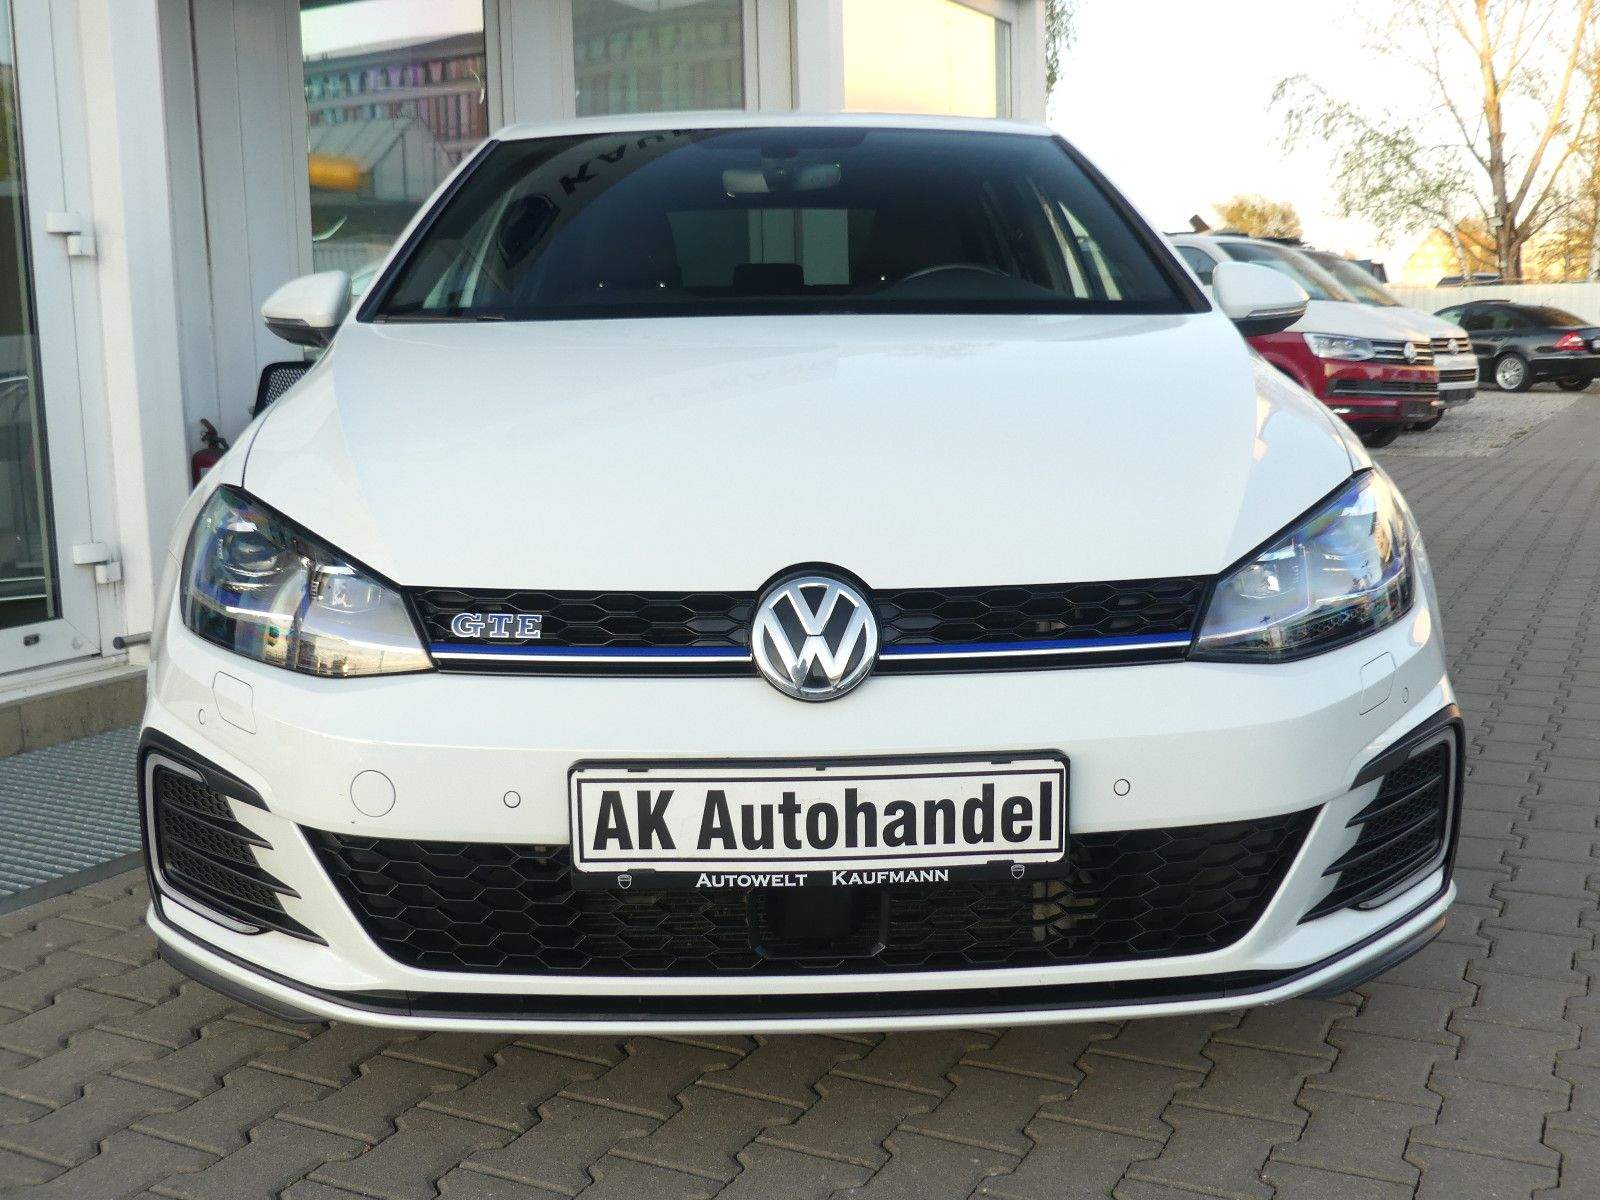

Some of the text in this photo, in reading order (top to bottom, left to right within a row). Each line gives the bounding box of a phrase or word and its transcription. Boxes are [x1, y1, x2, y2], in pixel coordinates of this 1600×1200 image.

[449, 612, 543, 639] GTE
[592, 781, 1053, 851] AK Autohandel
[694, 868, 950, 888] AUTOWELT KAUFMANN
